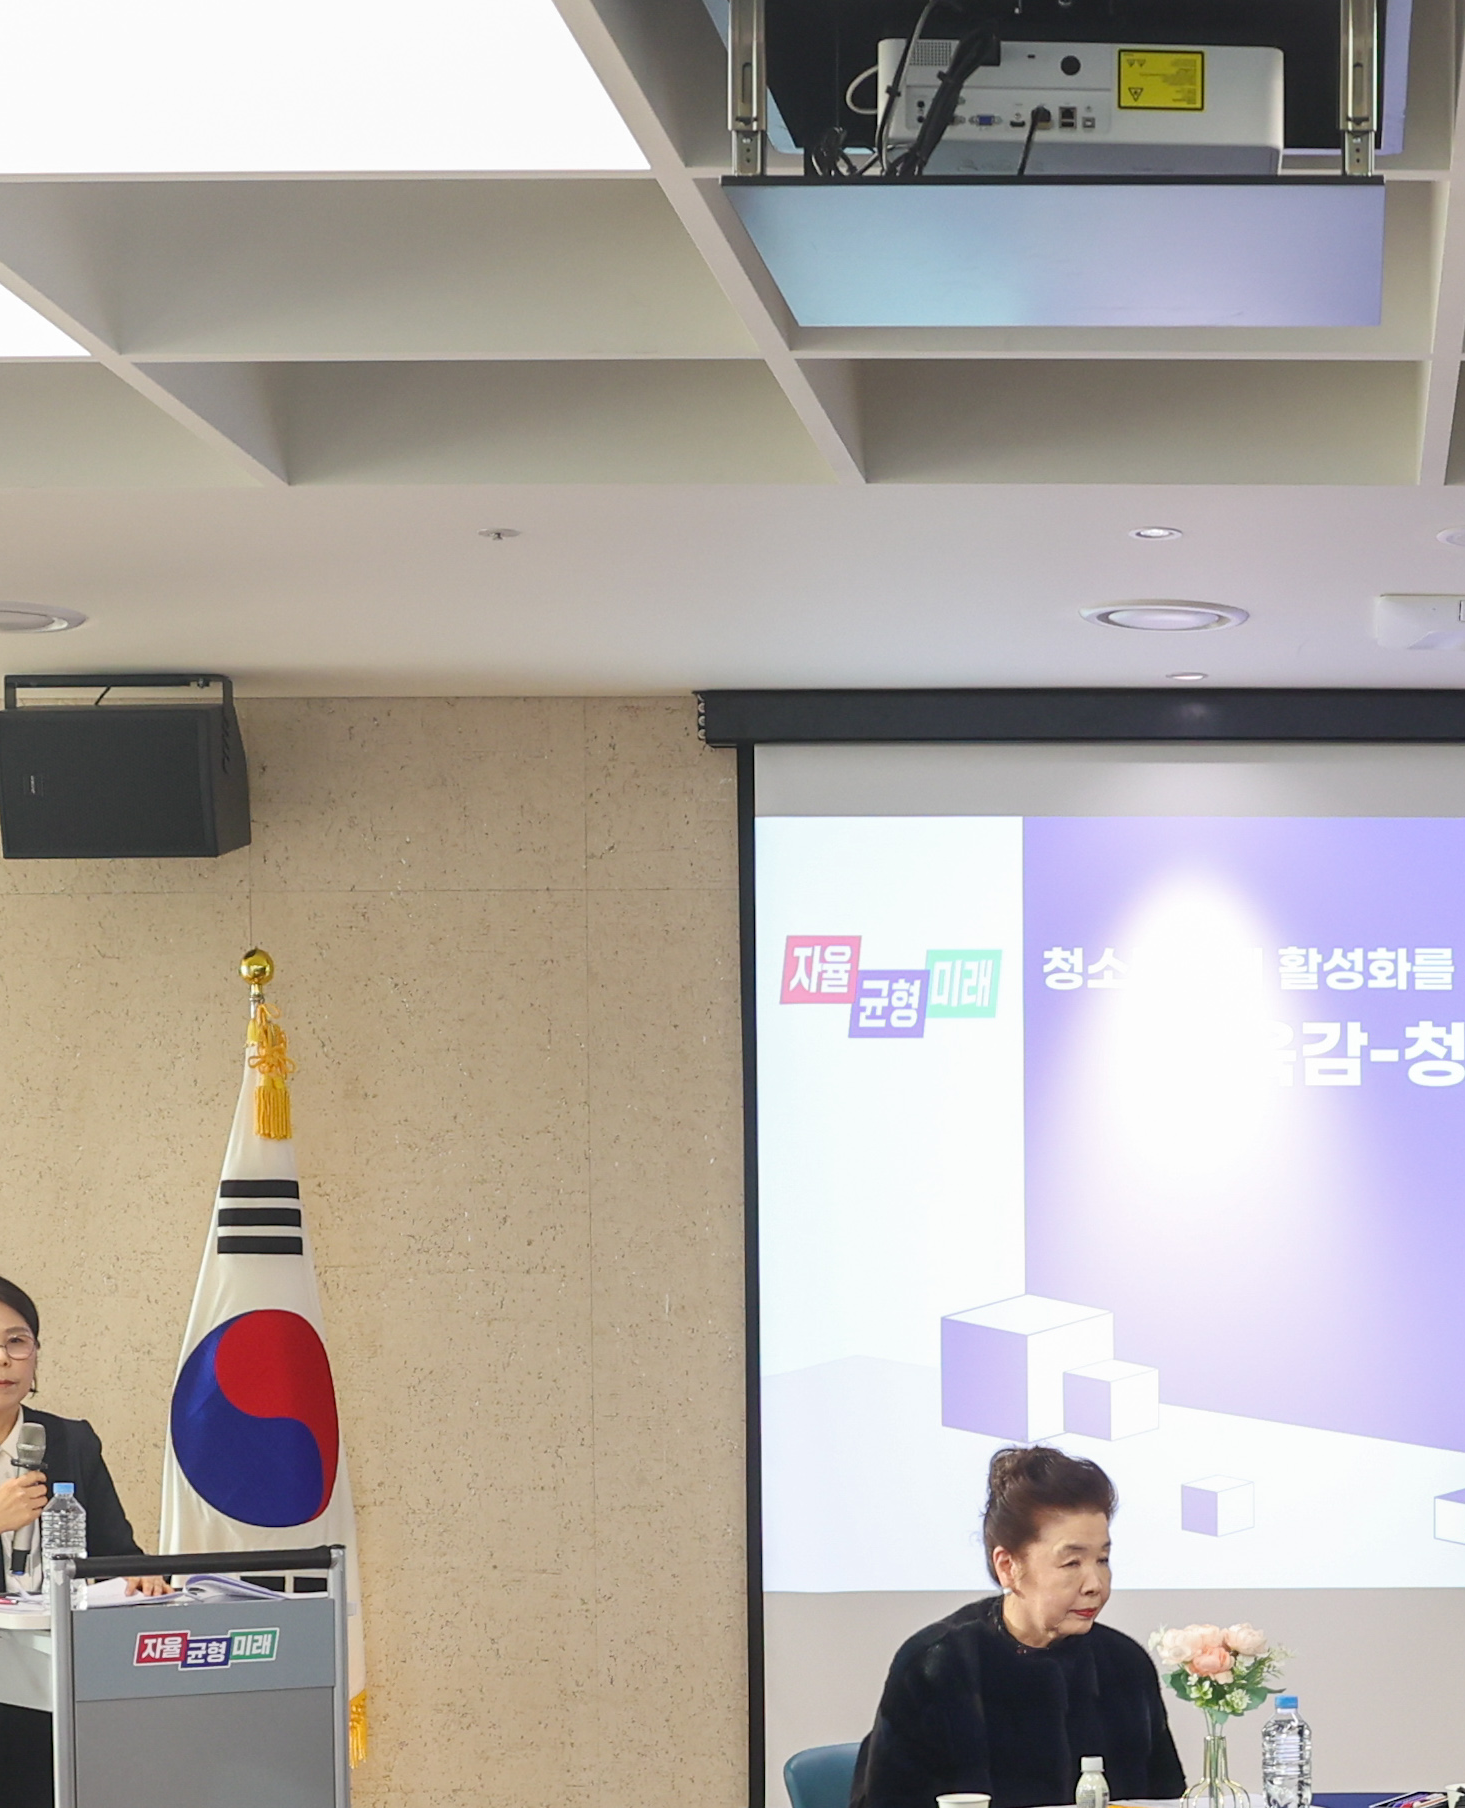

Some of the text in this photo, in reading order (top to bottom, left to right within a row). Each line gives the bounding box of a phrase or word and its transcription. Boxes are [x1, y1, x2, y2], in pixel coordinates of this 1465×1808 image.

[789, 945, 853, 993] 자율
[859, 979, 921, 1028] 균형
[930, 959, 994, 1008] 미래
[1278, 946, 1455, 991] 활성화를
[141, 1634, 273, 1664] 자율 균형 미래
